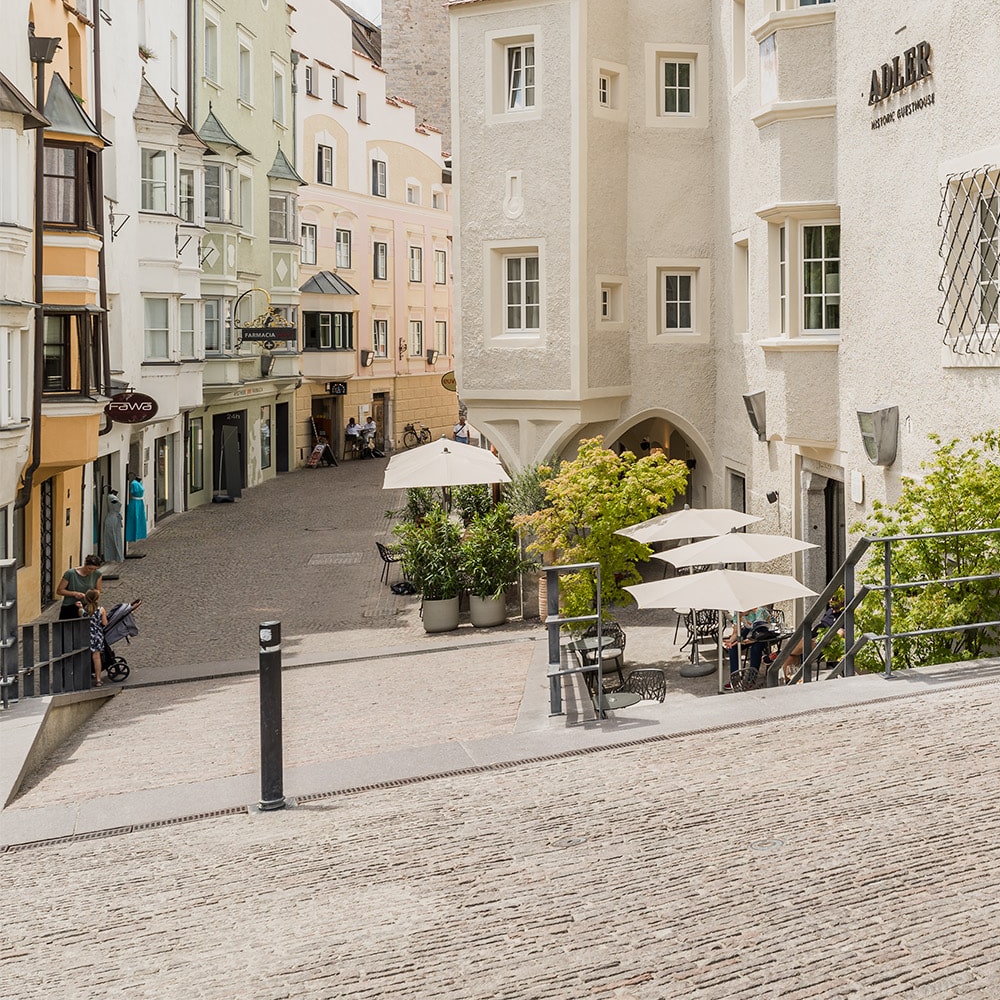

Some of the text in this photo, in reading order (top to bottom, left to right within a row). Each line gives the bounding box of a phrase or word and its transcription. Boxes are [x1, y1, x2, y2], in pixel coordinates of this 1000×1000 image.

[868, 40, 933, 106] ADLER
[871, 93, 935, 130] HISTORIC GUESTHOUSE
